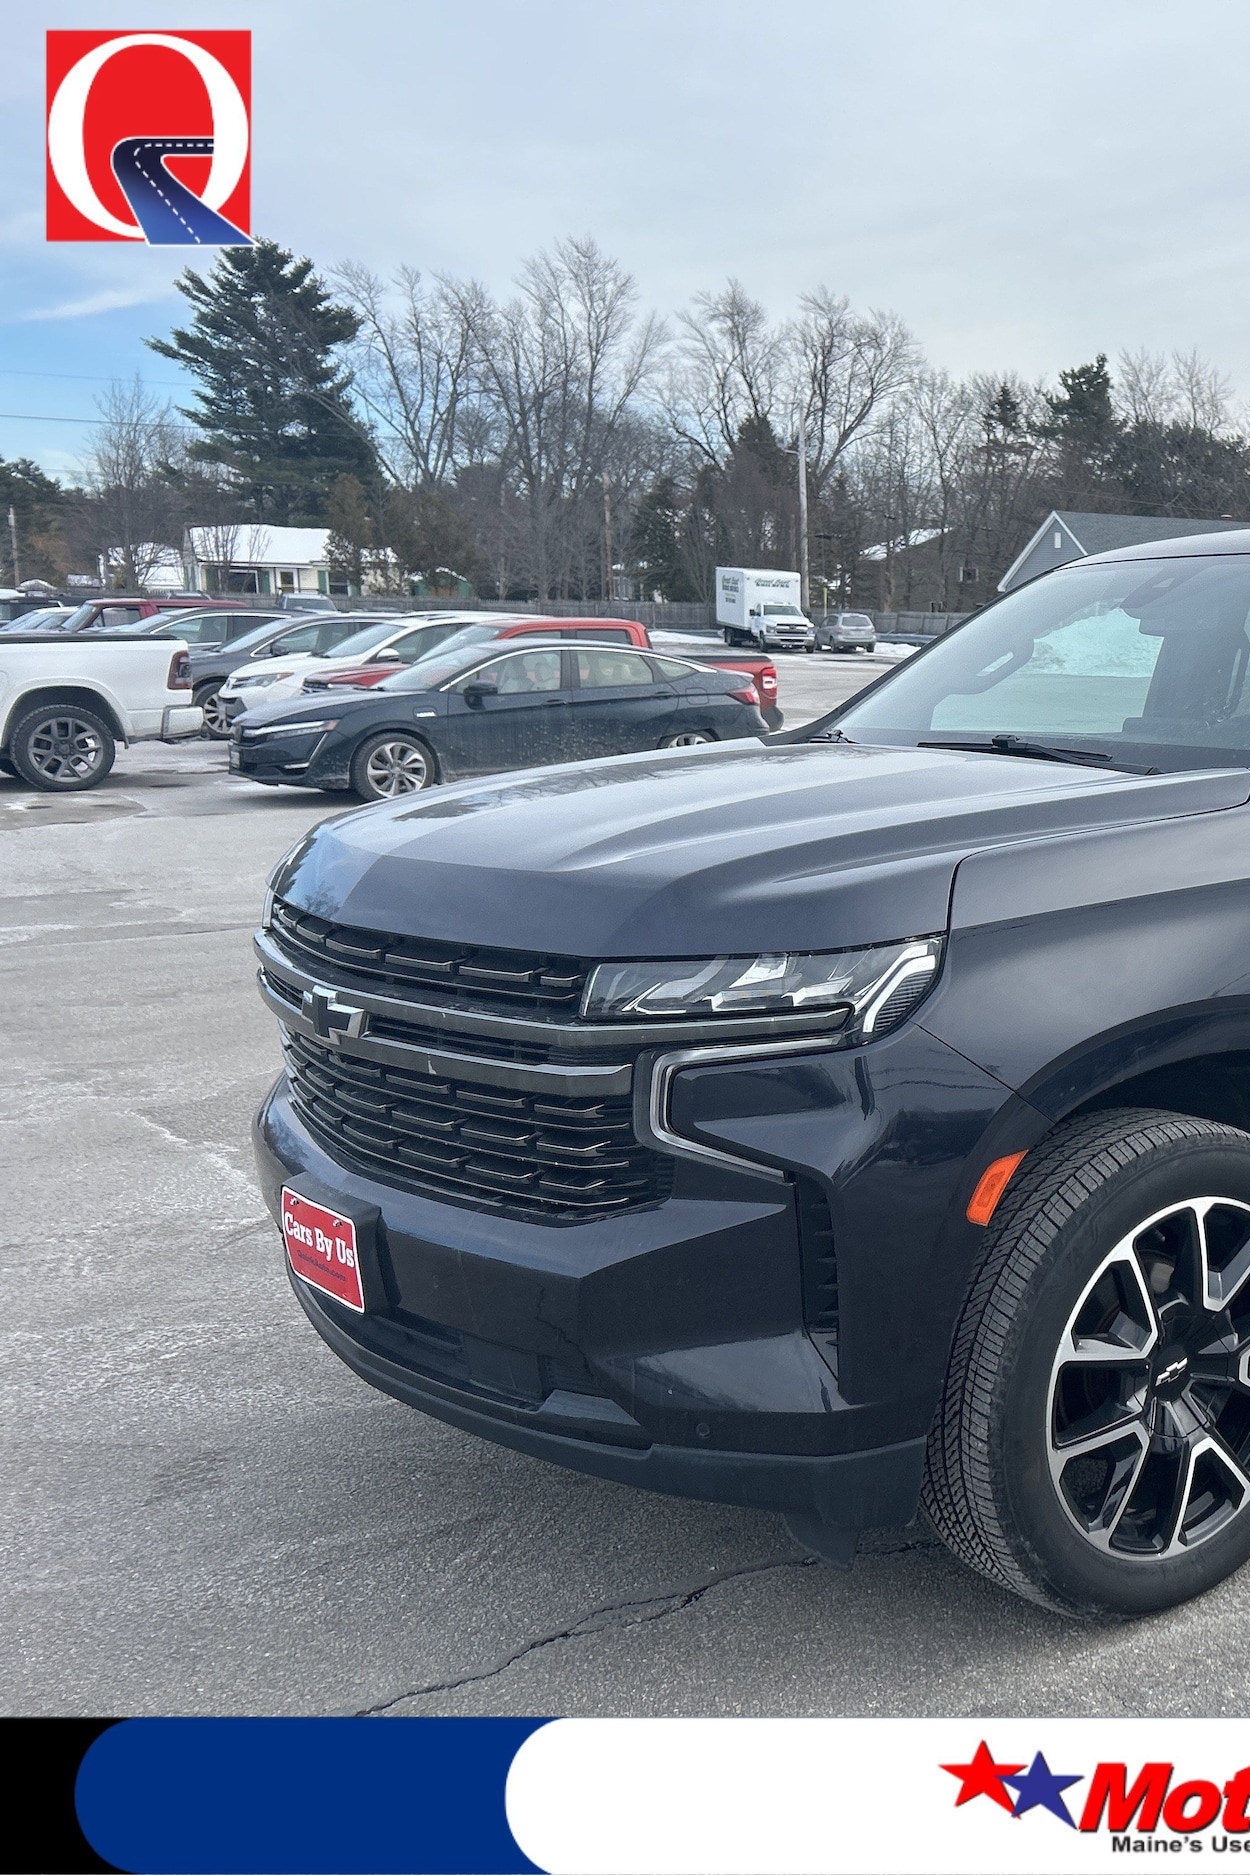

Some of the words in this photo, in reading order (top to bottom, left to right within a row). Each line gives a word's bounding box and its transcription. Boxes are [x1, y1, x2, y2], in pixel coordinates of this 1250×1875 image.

[284, 1211, 313, 1247] Cars
[314, 1226, 333, 1261] By
[335, 1236, 355, 1268] Us
